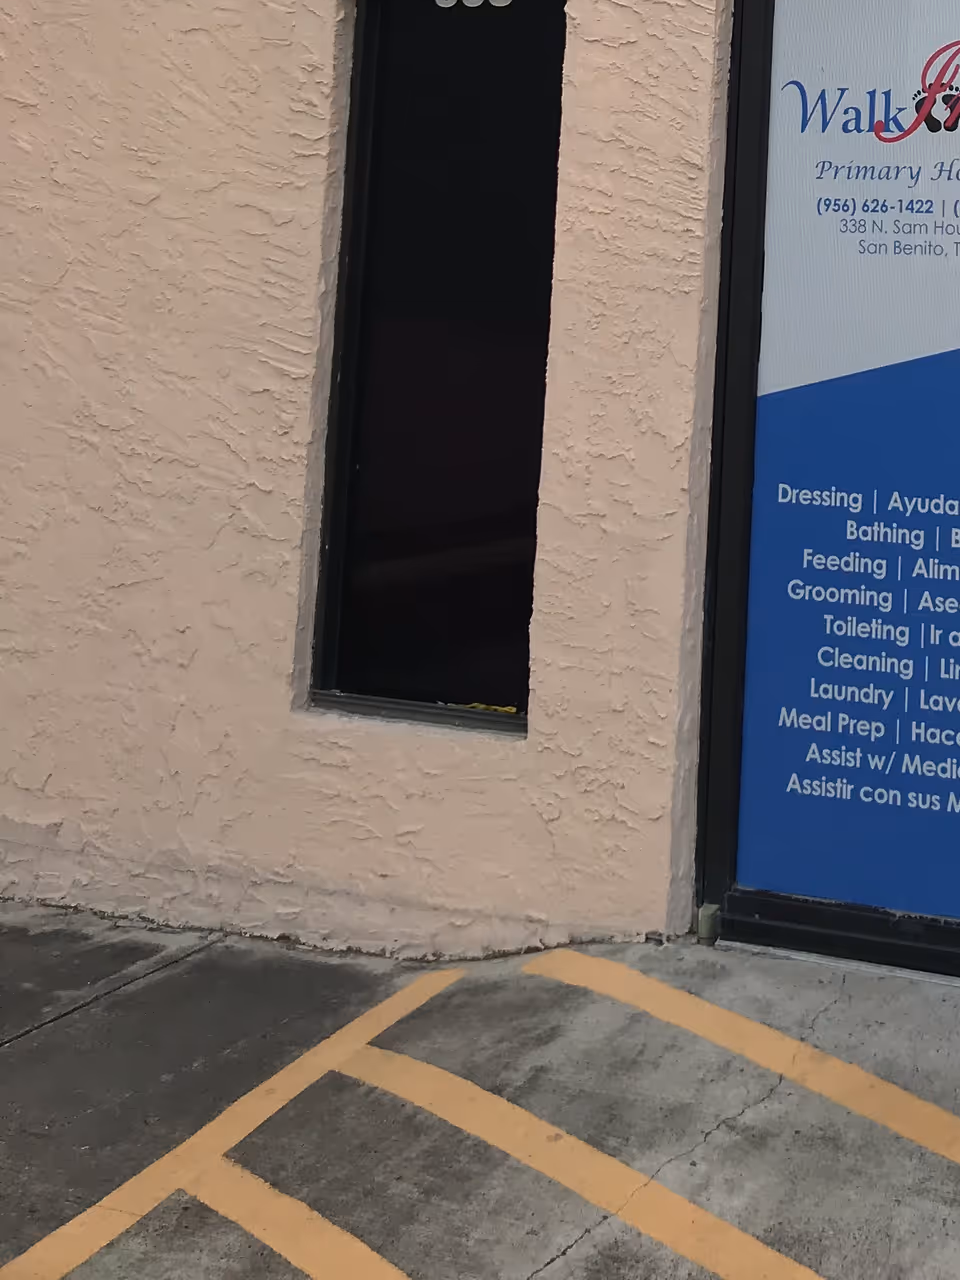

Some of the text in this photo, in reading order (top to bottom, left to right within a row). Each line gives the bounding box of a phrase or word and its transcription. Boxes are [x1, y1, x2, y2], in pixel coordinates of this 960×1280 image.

[781, 79, 907, 134] Walk
[815, 160, 922, 189] Primary
[816, 197, 857, 216] (956)
[861, 198, 934, 214] 626-1422
[839, 219, 867, 234] 338
[871, 220, 888, 234] N.
[892, 219, 929, 235] Sam
[858, 239, 888, 255] San
[893, 240, 949, 258] Benito,
[778, 483, 863, 513] Dressing
[846, 519, 925, 551] Bathing
[803, 548, 887, 580] Feeding
[787, 579, 893, 613] Grooming
[823, 614, 910, 647] Toileting
[929, 625, 943, 645] Ir
[817, 646, 914, 680] Cleaning
[810, 677, 894, 710] Laundry
[778, 707, 832, 732] Meal
[838, 712, 885, 742] Prep
[805, 742, 862, 768] Assist
[867, 751, 897, 775] w/
[785, 772, 855, 800] Assistir
[859, 786, 901, 806] con
[907, 791, 941, 811] sus
